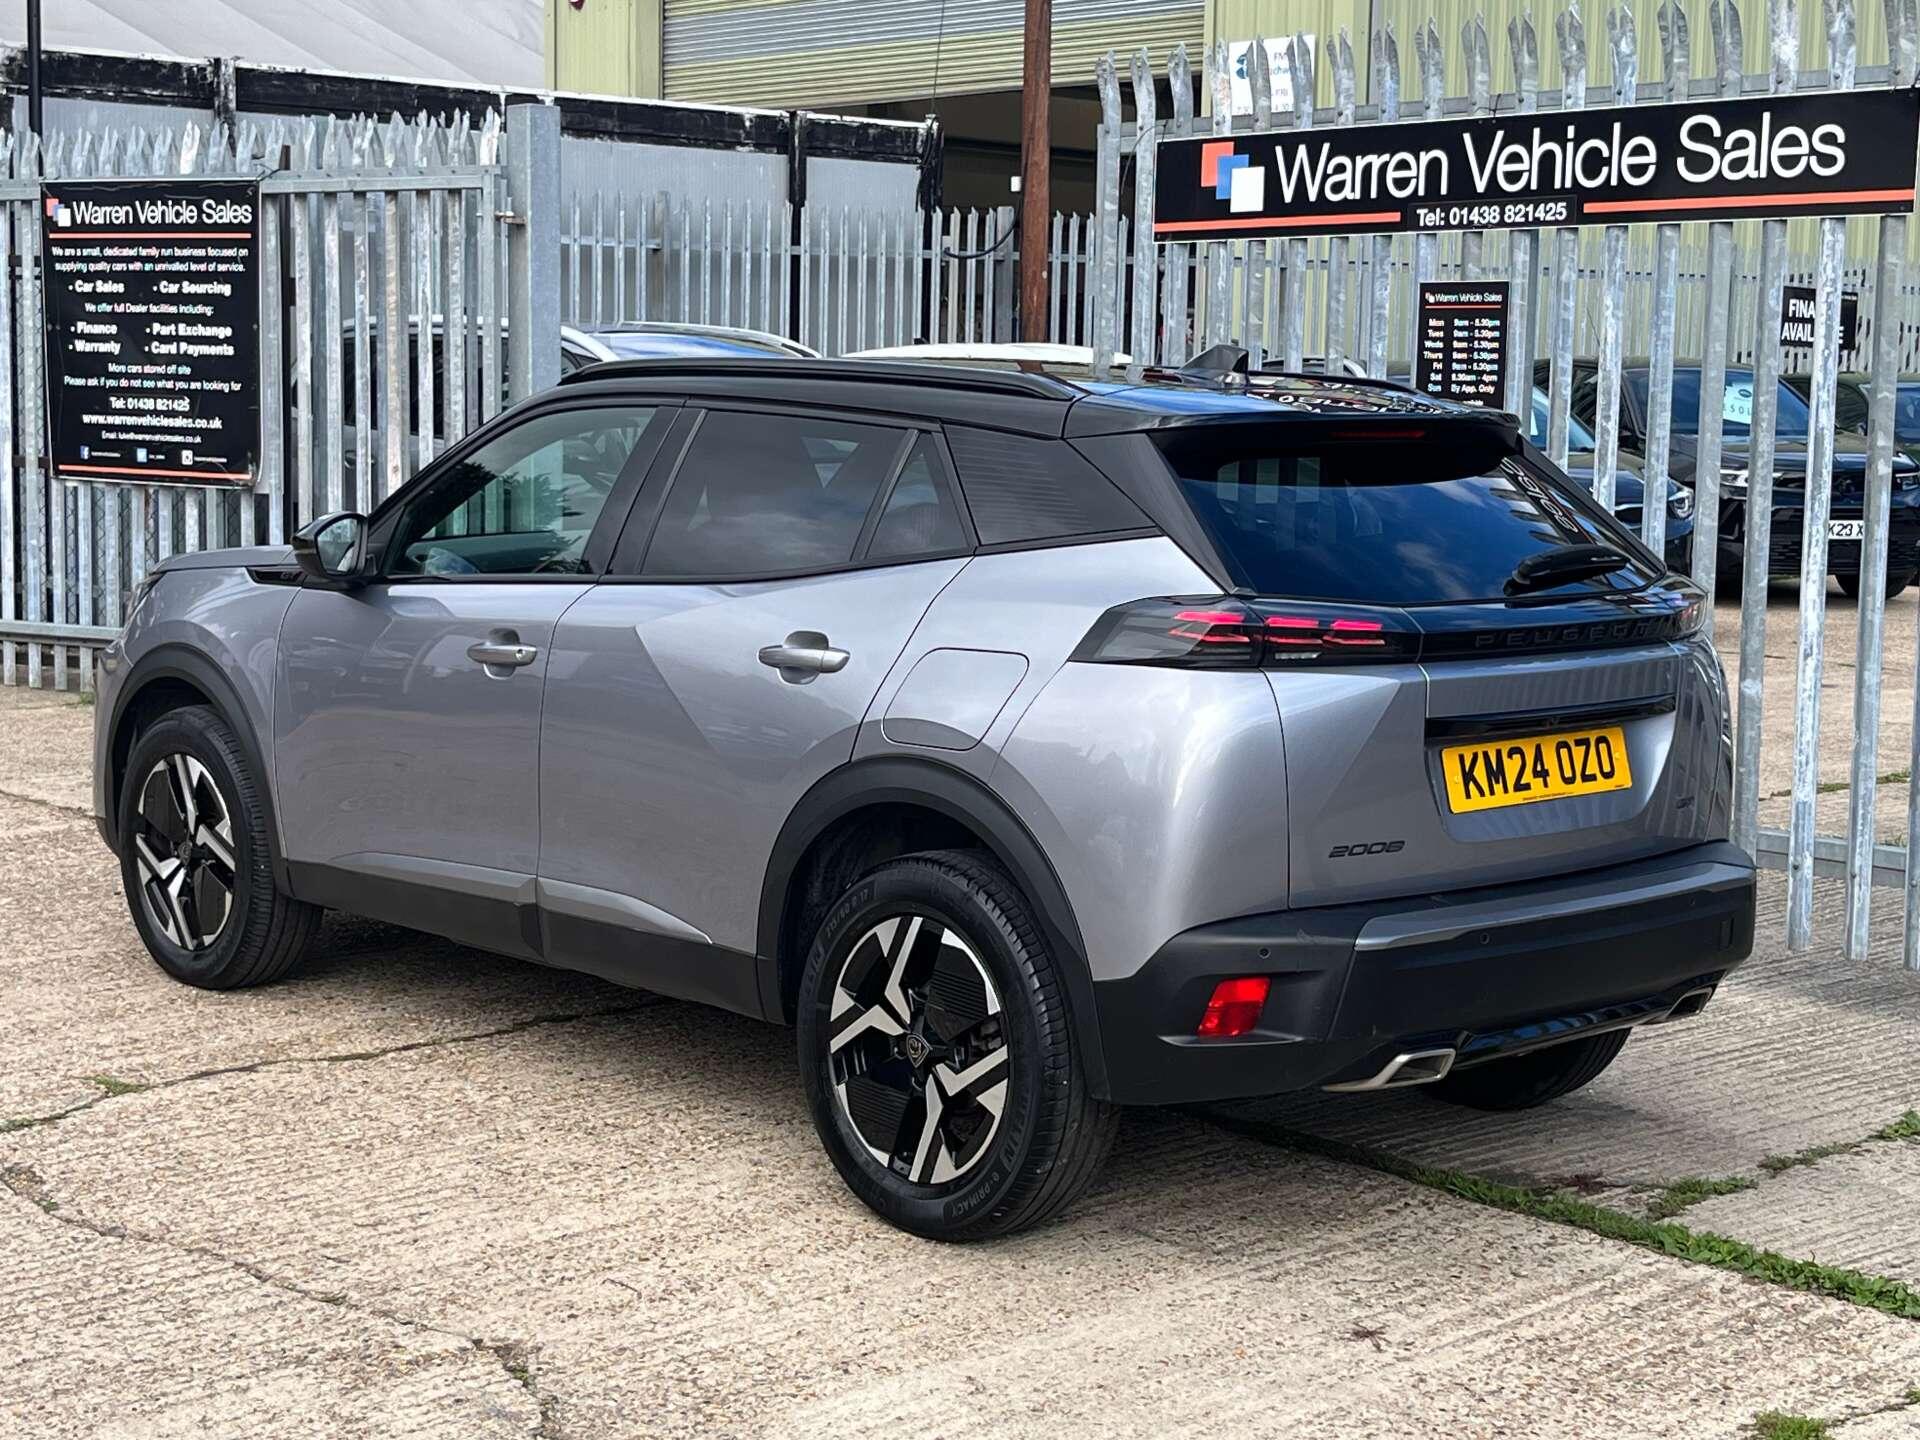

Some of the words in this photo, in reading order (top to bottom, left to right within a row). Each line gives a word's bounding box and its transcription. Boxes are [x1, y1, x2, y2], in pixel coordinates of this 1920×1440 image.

[1275, 142, 1448, 203] Warren
[1462, 121, 1657, 193] Vehicle
[1676, 111, 1846, 183] Sales
[72, 201, 133, 225] Warren
[135, 200, 198, 225] Vehicle
[202, 199, 252, 224] Sales
[1417, 208, 1445, 227] Tel:
[1449, 206, 1500, 225] 01438
[1504, 203, 1567, 223] 821425
[51, 246, 63, 256] We
[64, 248, 75, 256] are
[103, 246, 138, 256] dedicated
[139, 246, 160, 258] family
[160, 248, 173, 256] run
[174, 246, 206, 256] business
[207, 246, 237, 256] focused
[239, 248, 249, 256] on
[55, 261, 87, 273] supplying
[88, 261, 111, 272] quality
[112, 262, 127, 271] cars
[128, 261, 143, 271] with
[144, 263, 153, 271] an
[190, 262, 207, 271] level
[208, 262, 216, 271] of
[217, 262, 246, 272] service.
[75, 280, 94, 292] Car
[95, 280, 125, 293] Sales
[160, 280, 180, 293] Car
[181, 280, 232, 297] Sourcing
[84, 302, 96, 312] We
[97, 302, 113, 312] offer
[114, 302, 125, 312] full
[125, 302, 148, 313] Dealer
[1788, 298, 1816, 319] FINA
[76, 321, 118, 334] Finance
[152, 322, 176, 336] Part
[178, 322, 232, 339] Exchange
[74, 339, 121, 355] Warranty
[151, 341, 177, 354] Card
[179, 341, 235, 357] Payments
[108, 362, 126, 373] More
[127, 364, 142, 373] cars
[143, 364, 166, 374] stored
[167, 365, 177, 374] off
[178, 365, 191, 375] site
[64, 375, 86, 386] Please
[87, 377, 99, 386] ask
[105, 379, 118, 389] you
[119, 377, 129, 387] do
[130, 378, 141, 387] not
[143, 379, 155, 388] see
[156, 379, 174, 388] what
[174, 381, 188, 391] you
[190, 381, 202, 390] are
[203, 380, 229, 393] looking
[231, 381, 241, 390] for
[1827, 523, 1854, 536] K23
[1475, 622, 1651, 648] PEUGEOT
[1458, 742, 1550, 800] KM24
[1555, 735, 1616, 786] OZO
[1328, 840, 1405, 858] 2008
